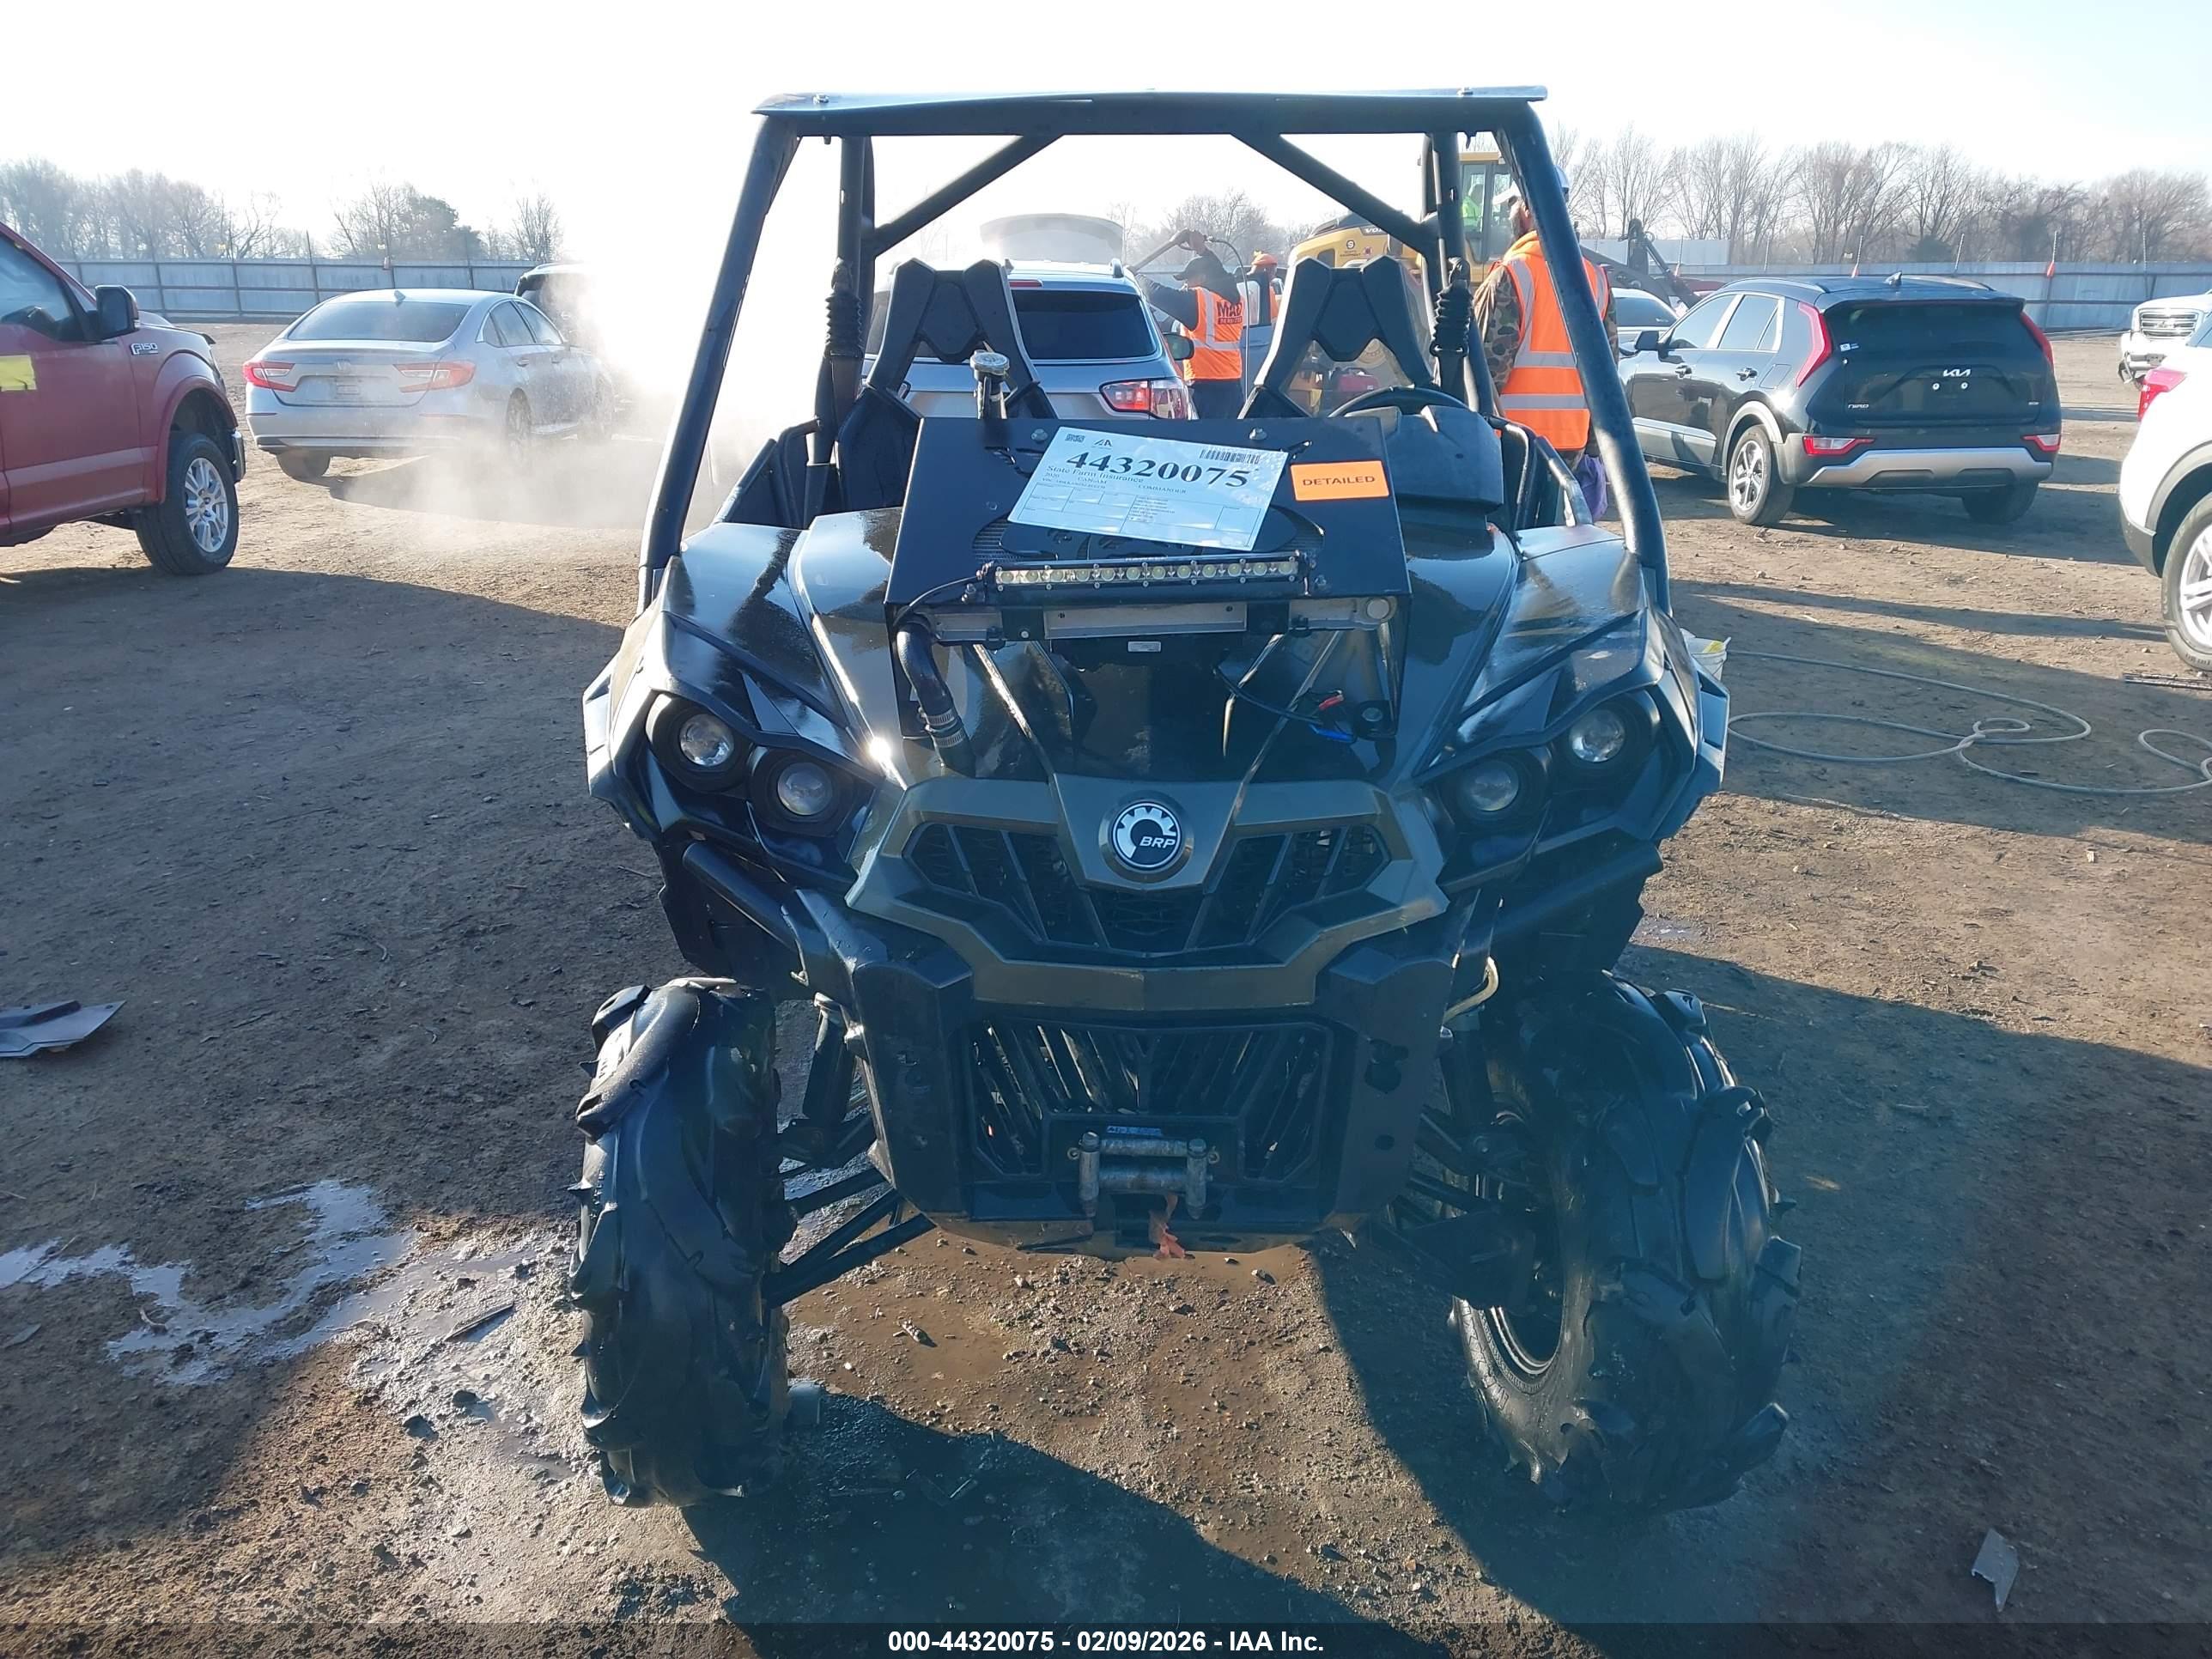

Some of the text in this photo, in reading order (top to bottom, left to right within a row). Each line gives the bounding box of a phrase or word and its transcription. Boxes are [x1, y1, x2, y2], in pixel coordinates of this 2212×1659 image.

[1216, 301, 1243, 317] MAD
[1942, 368, 1972, 377] KIA
[1047, 465, 1144, 483] State Farm Insurance
[1066, 452, 1252, 487] 44320075
[1302, 476, 1376, 486] DETAILED
[1139, 836, 1176, 848] BRP
